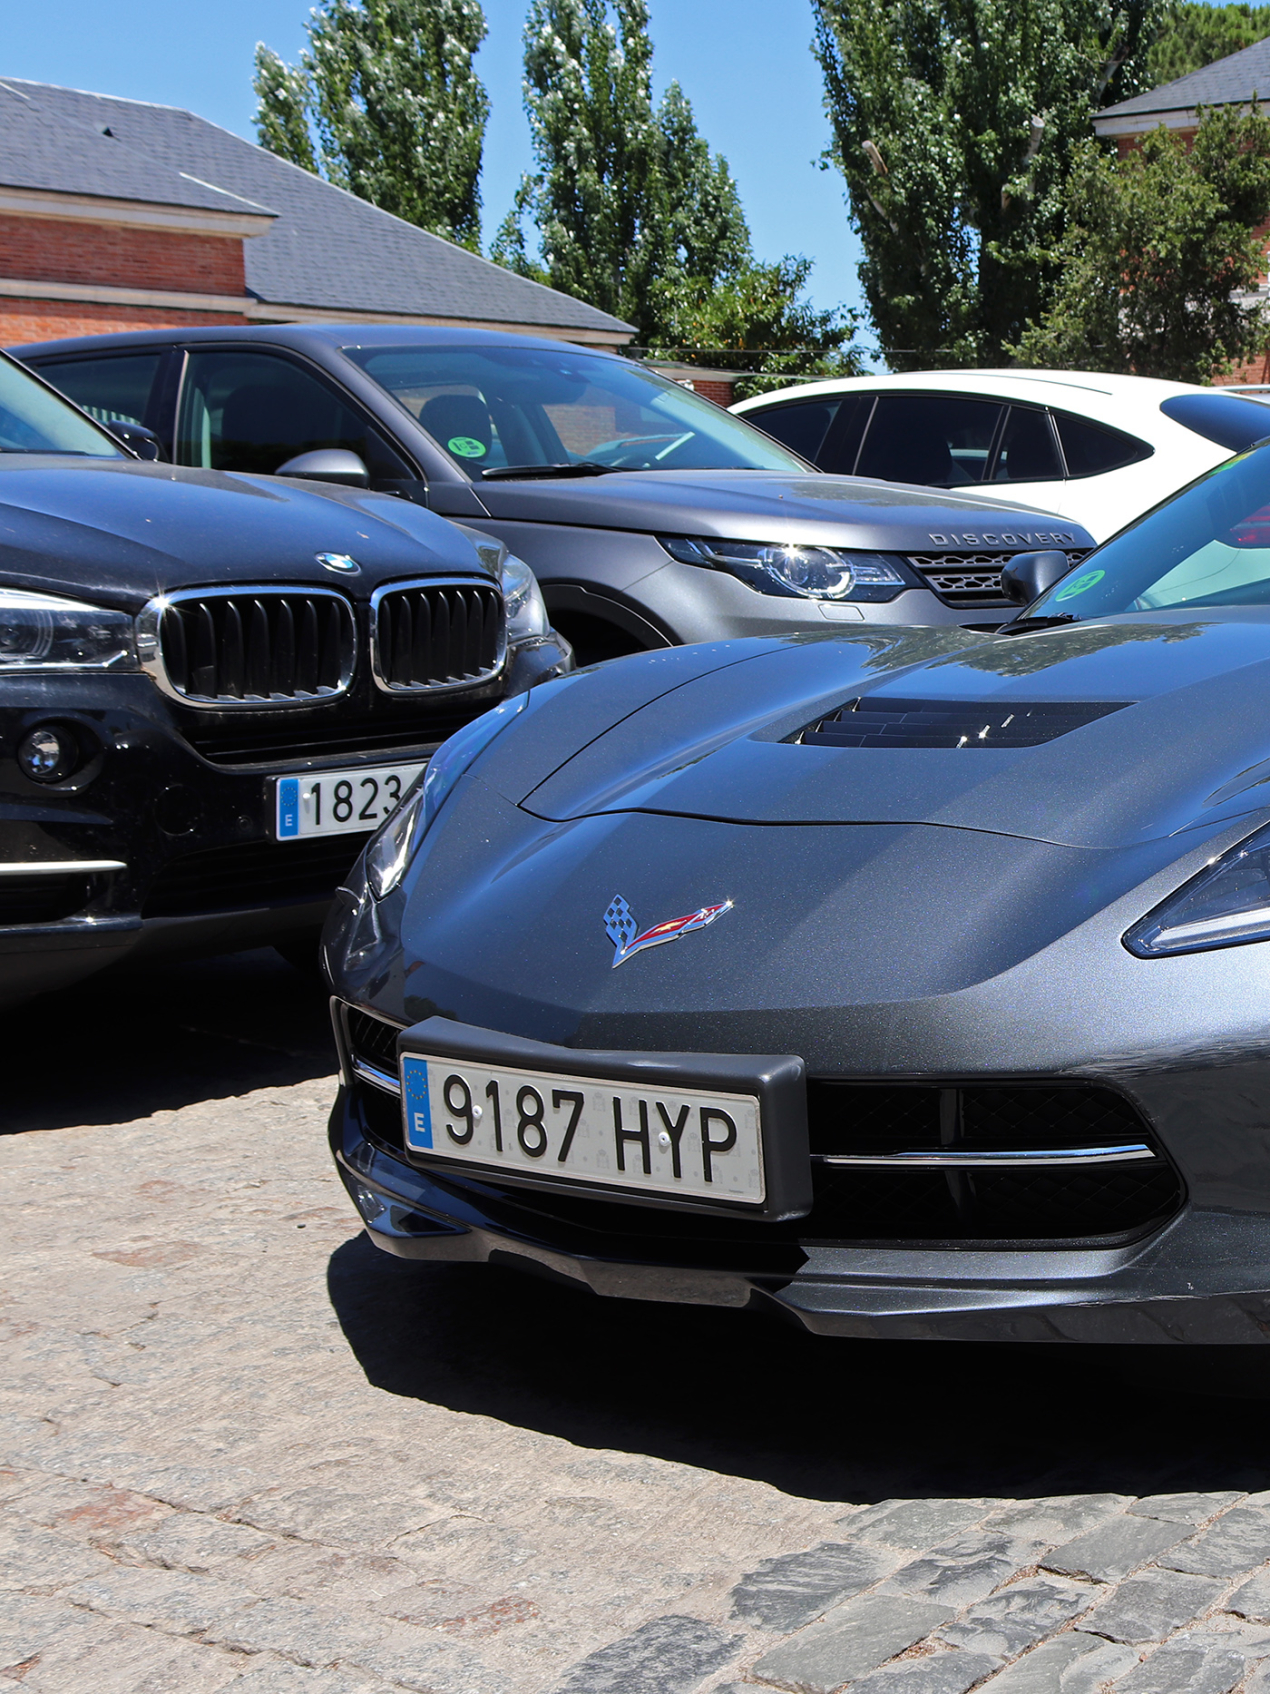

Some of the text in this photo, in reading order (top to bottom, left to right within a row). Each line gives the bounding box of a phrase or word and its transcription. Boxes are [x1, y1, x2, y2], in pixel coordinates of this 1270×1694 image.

[929, 532, 1076, 546] DISCOVERY
[311, 775, 401, 825] 1823
[285, 814, 293, 827] E
[413, 1113, 426, 1133] E
[443, 1074, 738, 1183] 9187 HYP
